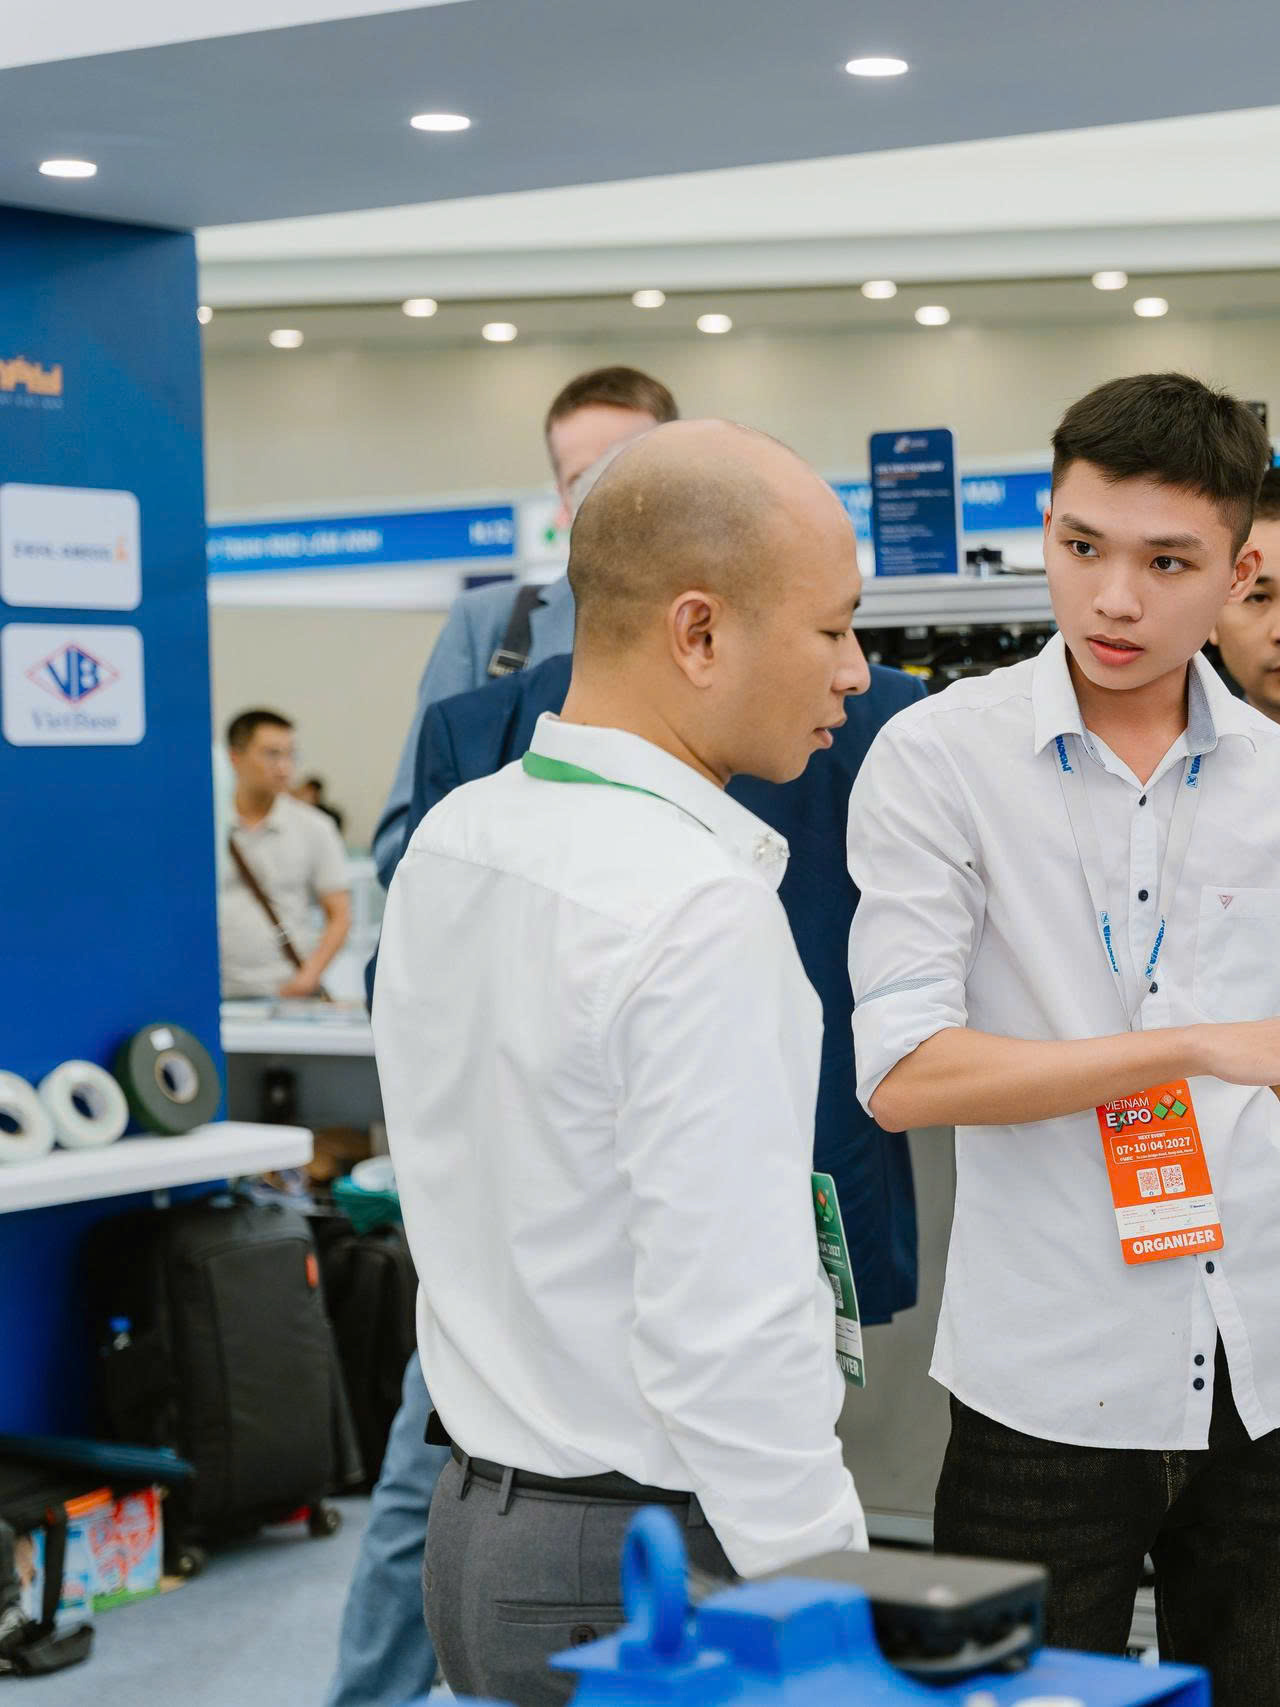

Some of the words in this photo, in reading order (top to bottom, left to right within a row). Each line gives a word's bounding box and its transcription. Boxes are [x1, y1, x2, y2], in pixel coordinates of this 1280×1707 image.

[1104, 1097, 1150, 1111] VIETNAM
[1106, 1109, 1153, 1132] EXPO
[1132, 1229, 1216, 1256] ORGANIZER
